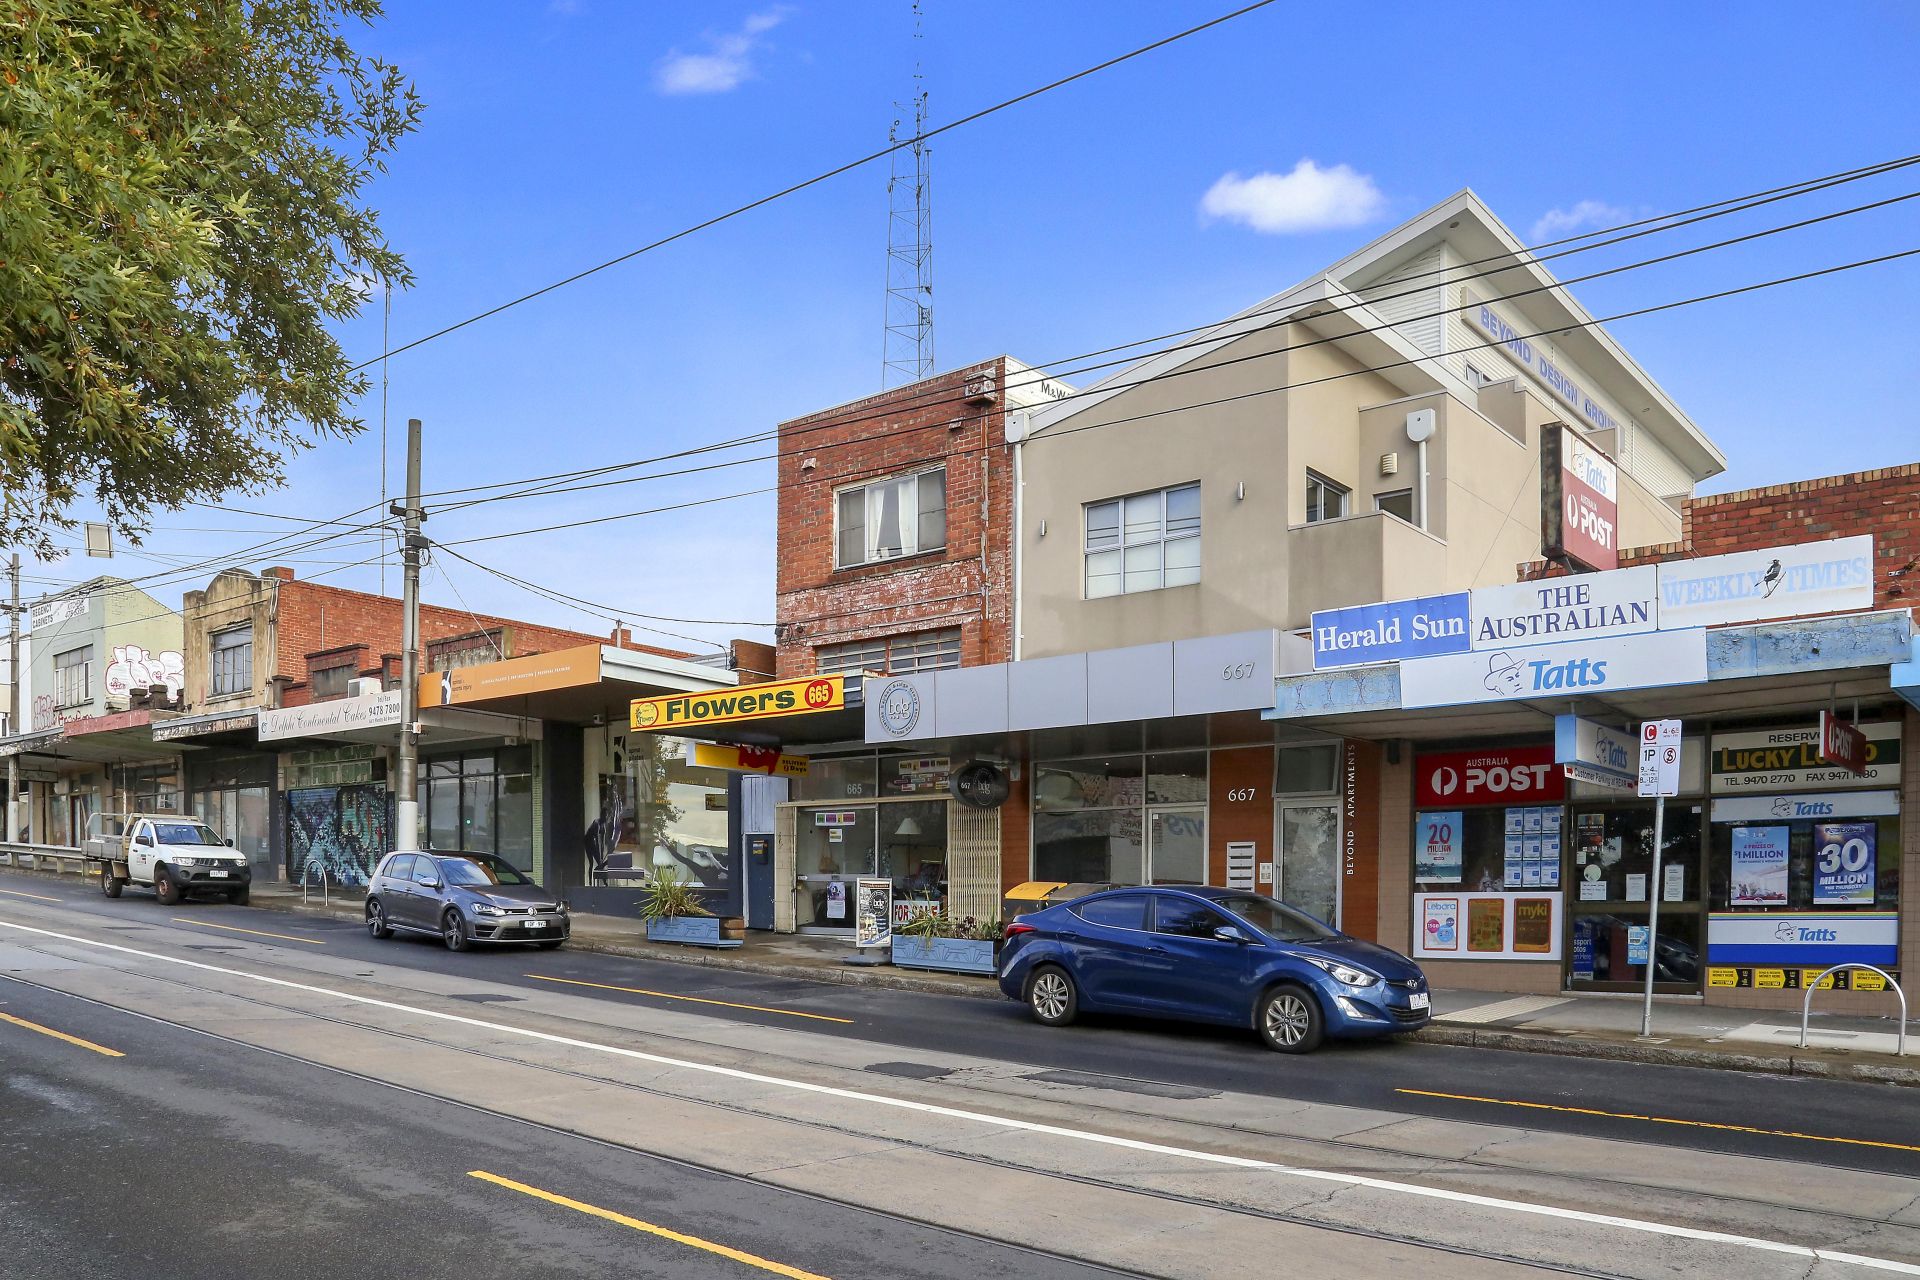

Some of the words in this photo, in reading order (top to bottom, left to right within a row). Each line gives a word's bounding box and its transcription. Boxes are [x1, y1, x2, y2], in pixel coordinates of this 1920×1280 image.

[1480, 305, 1531, 363] BEYOND
[1539, 356, 1578, 406] DESIGN
[1585, 457, 1608, 495] Tatts
[1580, 493, 1598, 513] AUSTRALIA
[1580, 505, 1613, 550] POST
[1662, 571, 1765, 608] WEEKLY
[1785, 557, 1867, 593] TIMES
[1537, 584, 1590, 609] THE
[32, 603, 52, 617] REGENCY
[32, 614, 54, 628] CABINETS
[1476, 600, 1650, 641] AUSTRALIAN
[1317, 617, 1401, 652] Herald
[1412, 614, 1466, 641] Sun
[1222, 662, 1256, 680] 667
[1528, 656, 1608, 691] Tatts
[368, 704, 383, 717] 9478
[385, 702, 400, 714] 7800
[666, 689, 796, 722] Flowers
[808, 684, 829, 704] 665
[889, 698, 912, 720] bdg
[297, 708, 342, 729] Continental
[342, 703, 367, 722] Cakes
[1768, 732, 1821, 744] RESERV
[1835, 727, 1852, 761] POST
[1466, 757, 1510, 767] AUSTRALIA
[1607, 740, 1628, 769] Tatts
[1644, 749, 1656, 762] 1P
[1721, 747, 1796, 771] LUCKY
[961, 782, 971, 790] 667
[1347, 744, 1355, 818] APARTMENTS
[1466, 764, 1551, 793] POST
[1574, 768, 1596, 780] Customer
[1595, 773, 1611, 787] Parking
[1770, 774, 1796, 783] 2770
[1806, 772, 1826, 782] FAX
[1828, 771, 1849, 781] 9471
[847, 783, 862, 795] 665
[1228, 788, 1256, 802] 667
[1794, 801, 1834, 816] Tatts
[1428, 823, 1452, 845] 20
[1346, 830, 1354, 875] BEYOND
[1427, 845, 1452, 853] MILLION
[1742, 850, 1784, 859] MILLION
[1820, 873, 1867, 885] MILLION
[894, 904, 909, 922] FOR
[1426, 902, 1456, 911] Lebara
[1518, 903, 1548, 919] myki
[1797, 927, 1837, 942] Tatts
